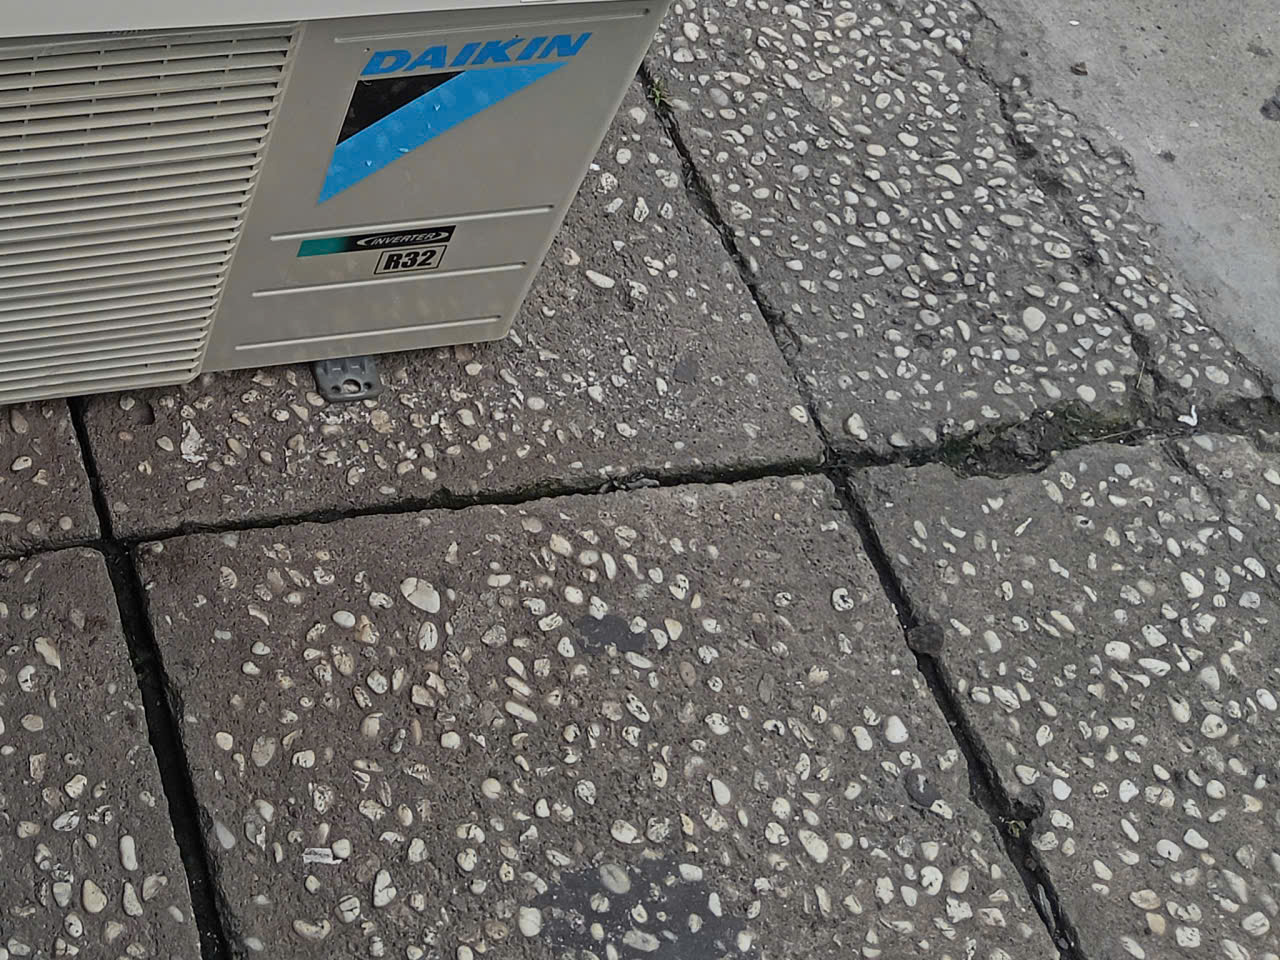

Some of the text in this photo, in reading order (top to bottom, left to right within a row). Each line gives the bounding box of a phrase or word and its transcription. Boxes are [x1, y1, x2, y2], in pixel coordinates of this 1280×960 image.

[360, 32, 592, 76] DAIKIN
[371, 232, 435, 246] INVERTER
[383, 249, 437, 271] R32
